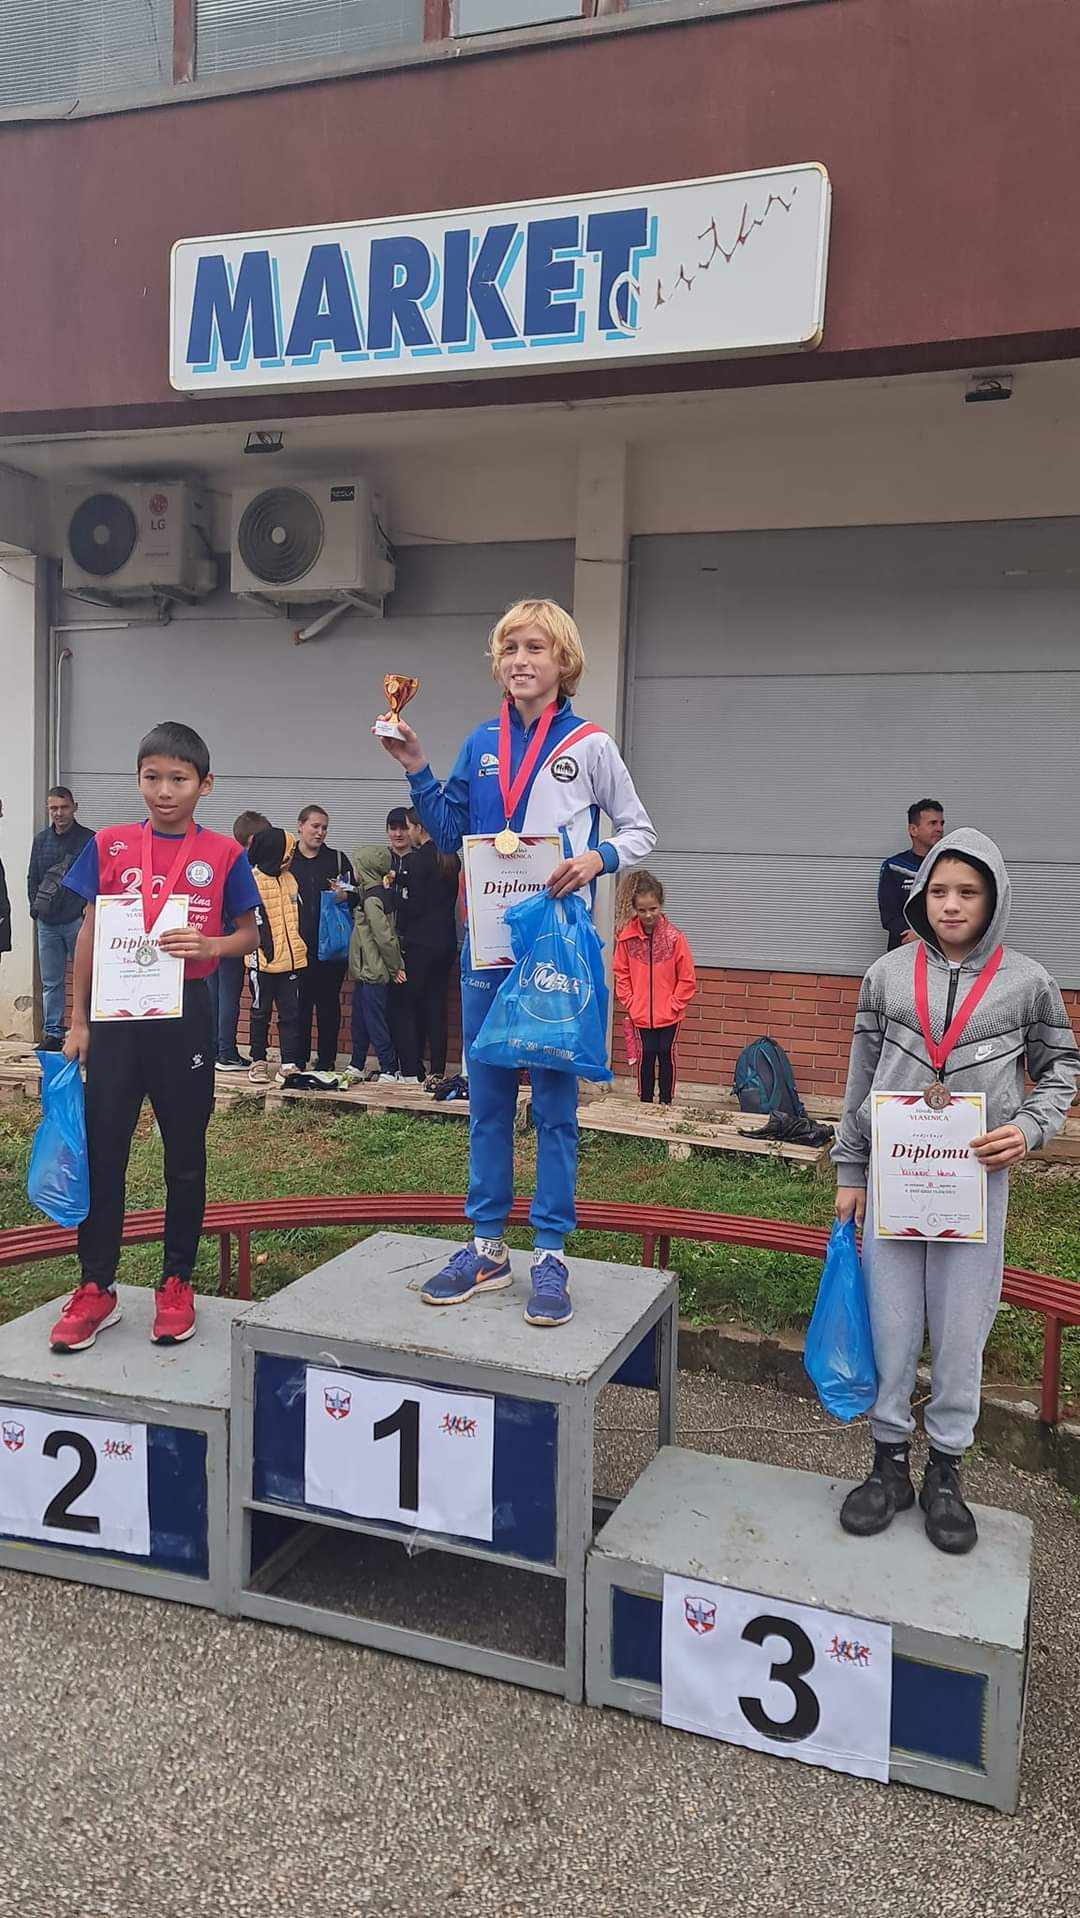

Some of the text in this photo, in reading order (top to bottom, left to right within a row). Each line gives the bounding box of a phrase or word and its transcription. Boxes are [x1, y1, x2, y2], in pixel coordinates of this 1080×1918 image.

[185, 207, 657, 374] MARKET
[151, 519, 166, 530] LG
[110, 935, 161, 953] Diplom
[891, 1143, 970, 1164] Diplomu
[42, 1430, 100, 1535] 2
[373, 1399, 421, 1512] 1
[738, 1615, 820, 1743] 3
